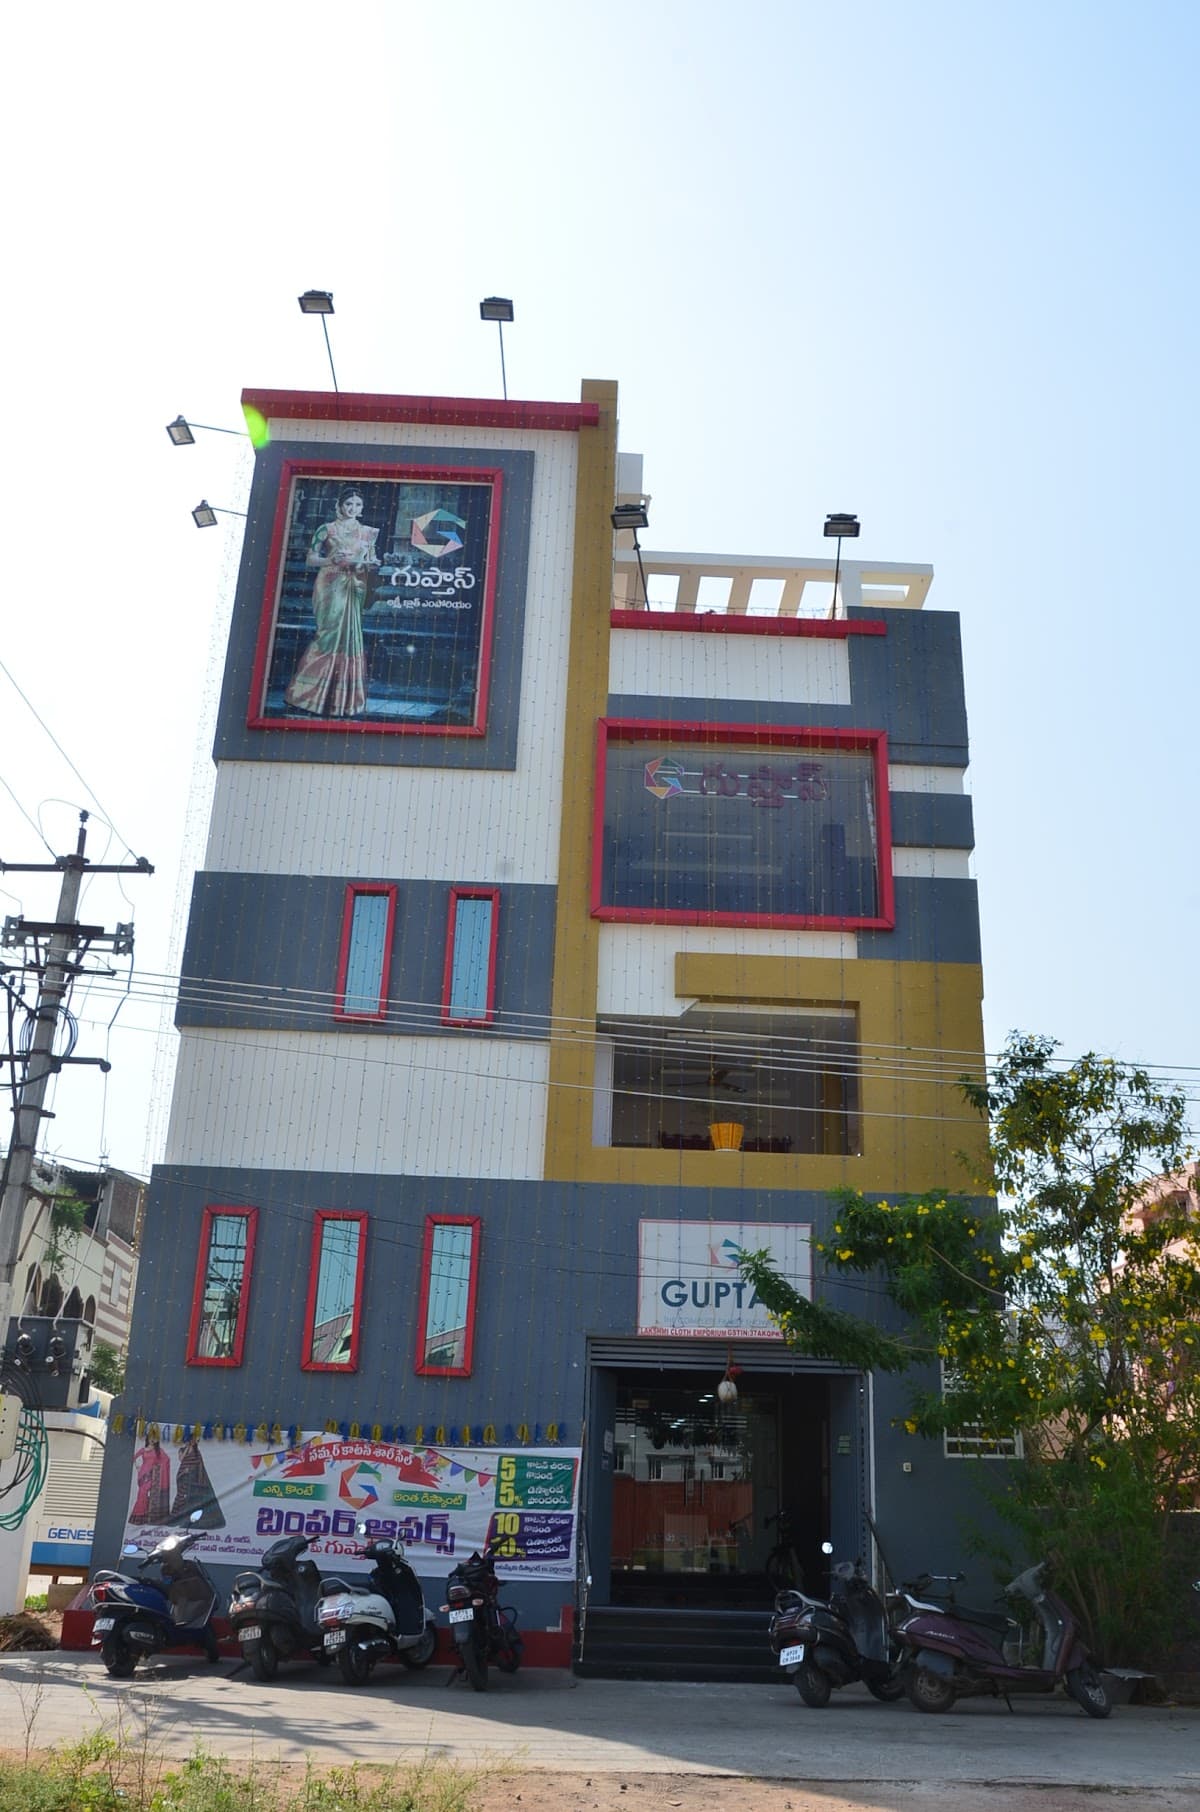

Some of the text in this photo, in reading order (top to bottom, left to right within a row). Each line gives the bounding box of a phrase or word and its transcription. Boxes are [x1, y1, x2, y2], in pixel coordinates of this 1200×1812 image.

[391, 565, 475, 595] గుప్తాస్
[693, 1329, 727, 1337] EMPORIUM
[501, 1457, 516, 1481] 5
[256, 1507, 455, 1555] బంపర్ ఆఫర్స్
[494, 1513, 519, 1535] 10
